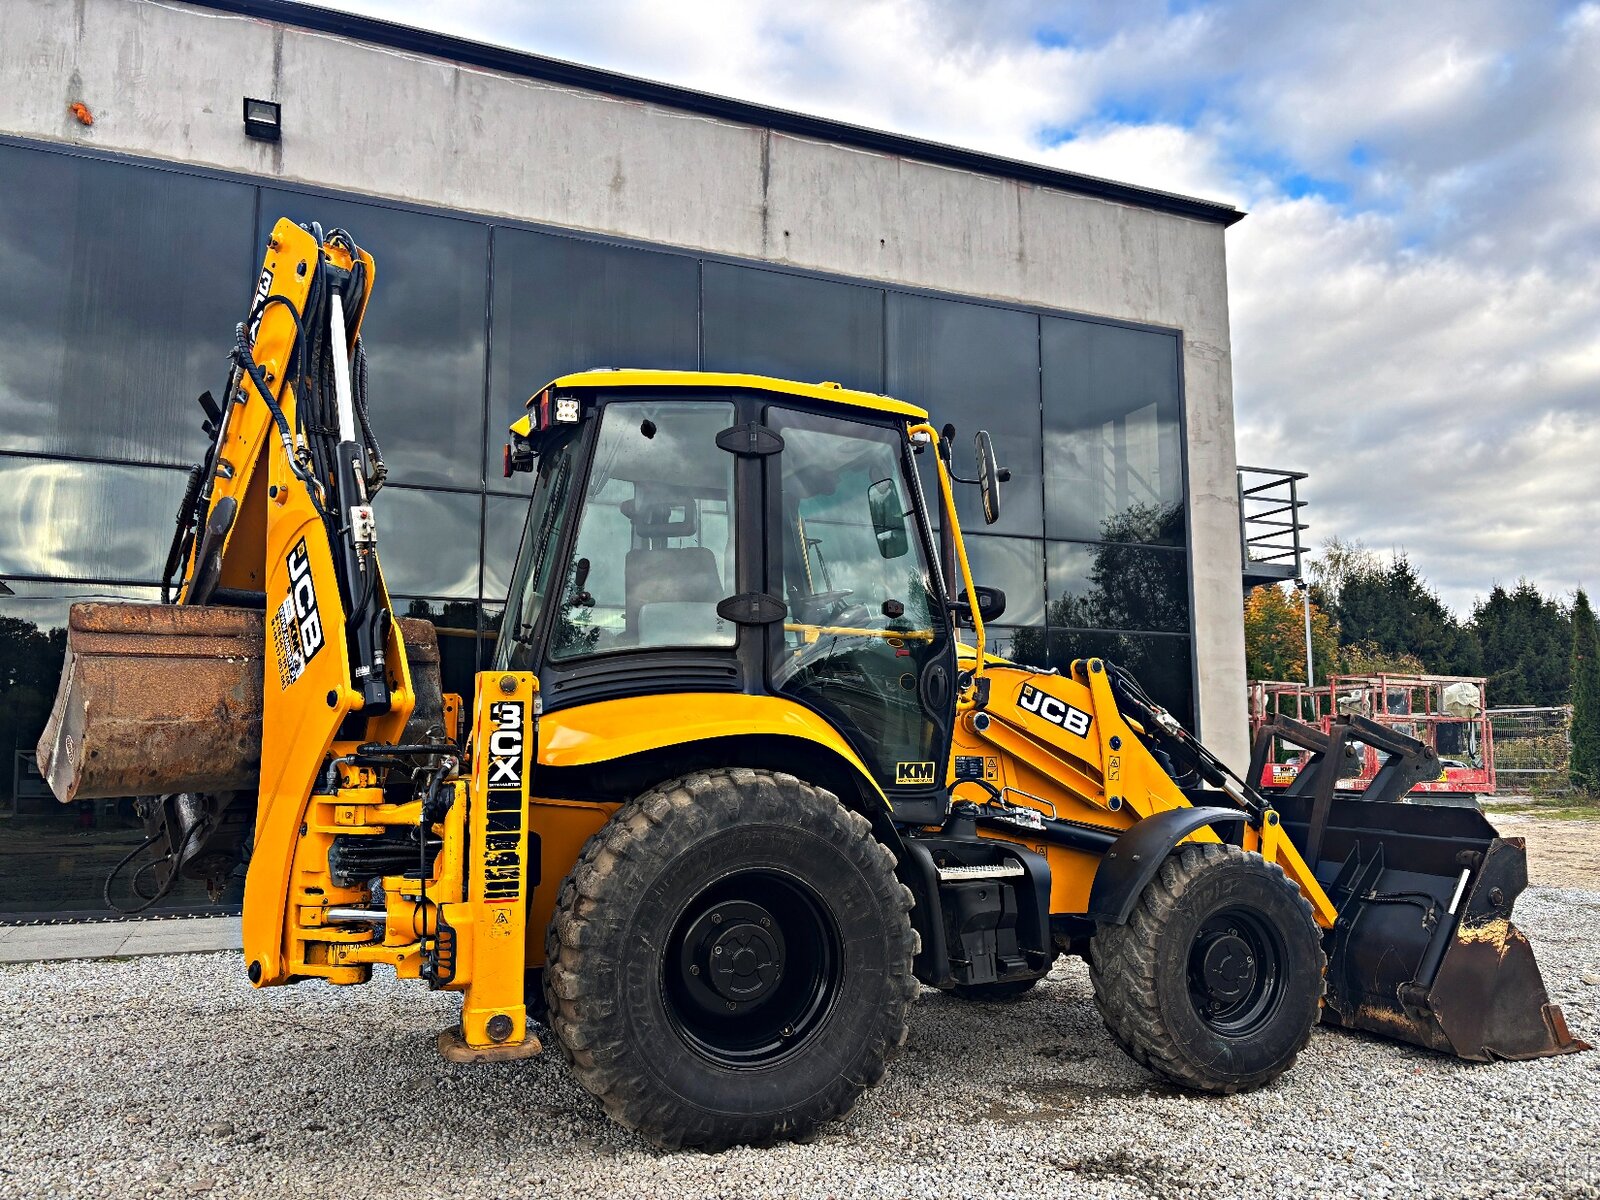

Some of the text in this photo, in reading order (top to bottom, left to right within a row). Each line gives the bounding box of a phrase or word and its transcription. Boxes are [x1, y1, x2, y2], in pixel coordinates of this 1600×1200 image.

[288, 551, 322, 658] JCB
[489, 704, 523, 781] 3CX
[1020, 691, 1089, 736] JCB
[898, 763, 934, 779] KM
